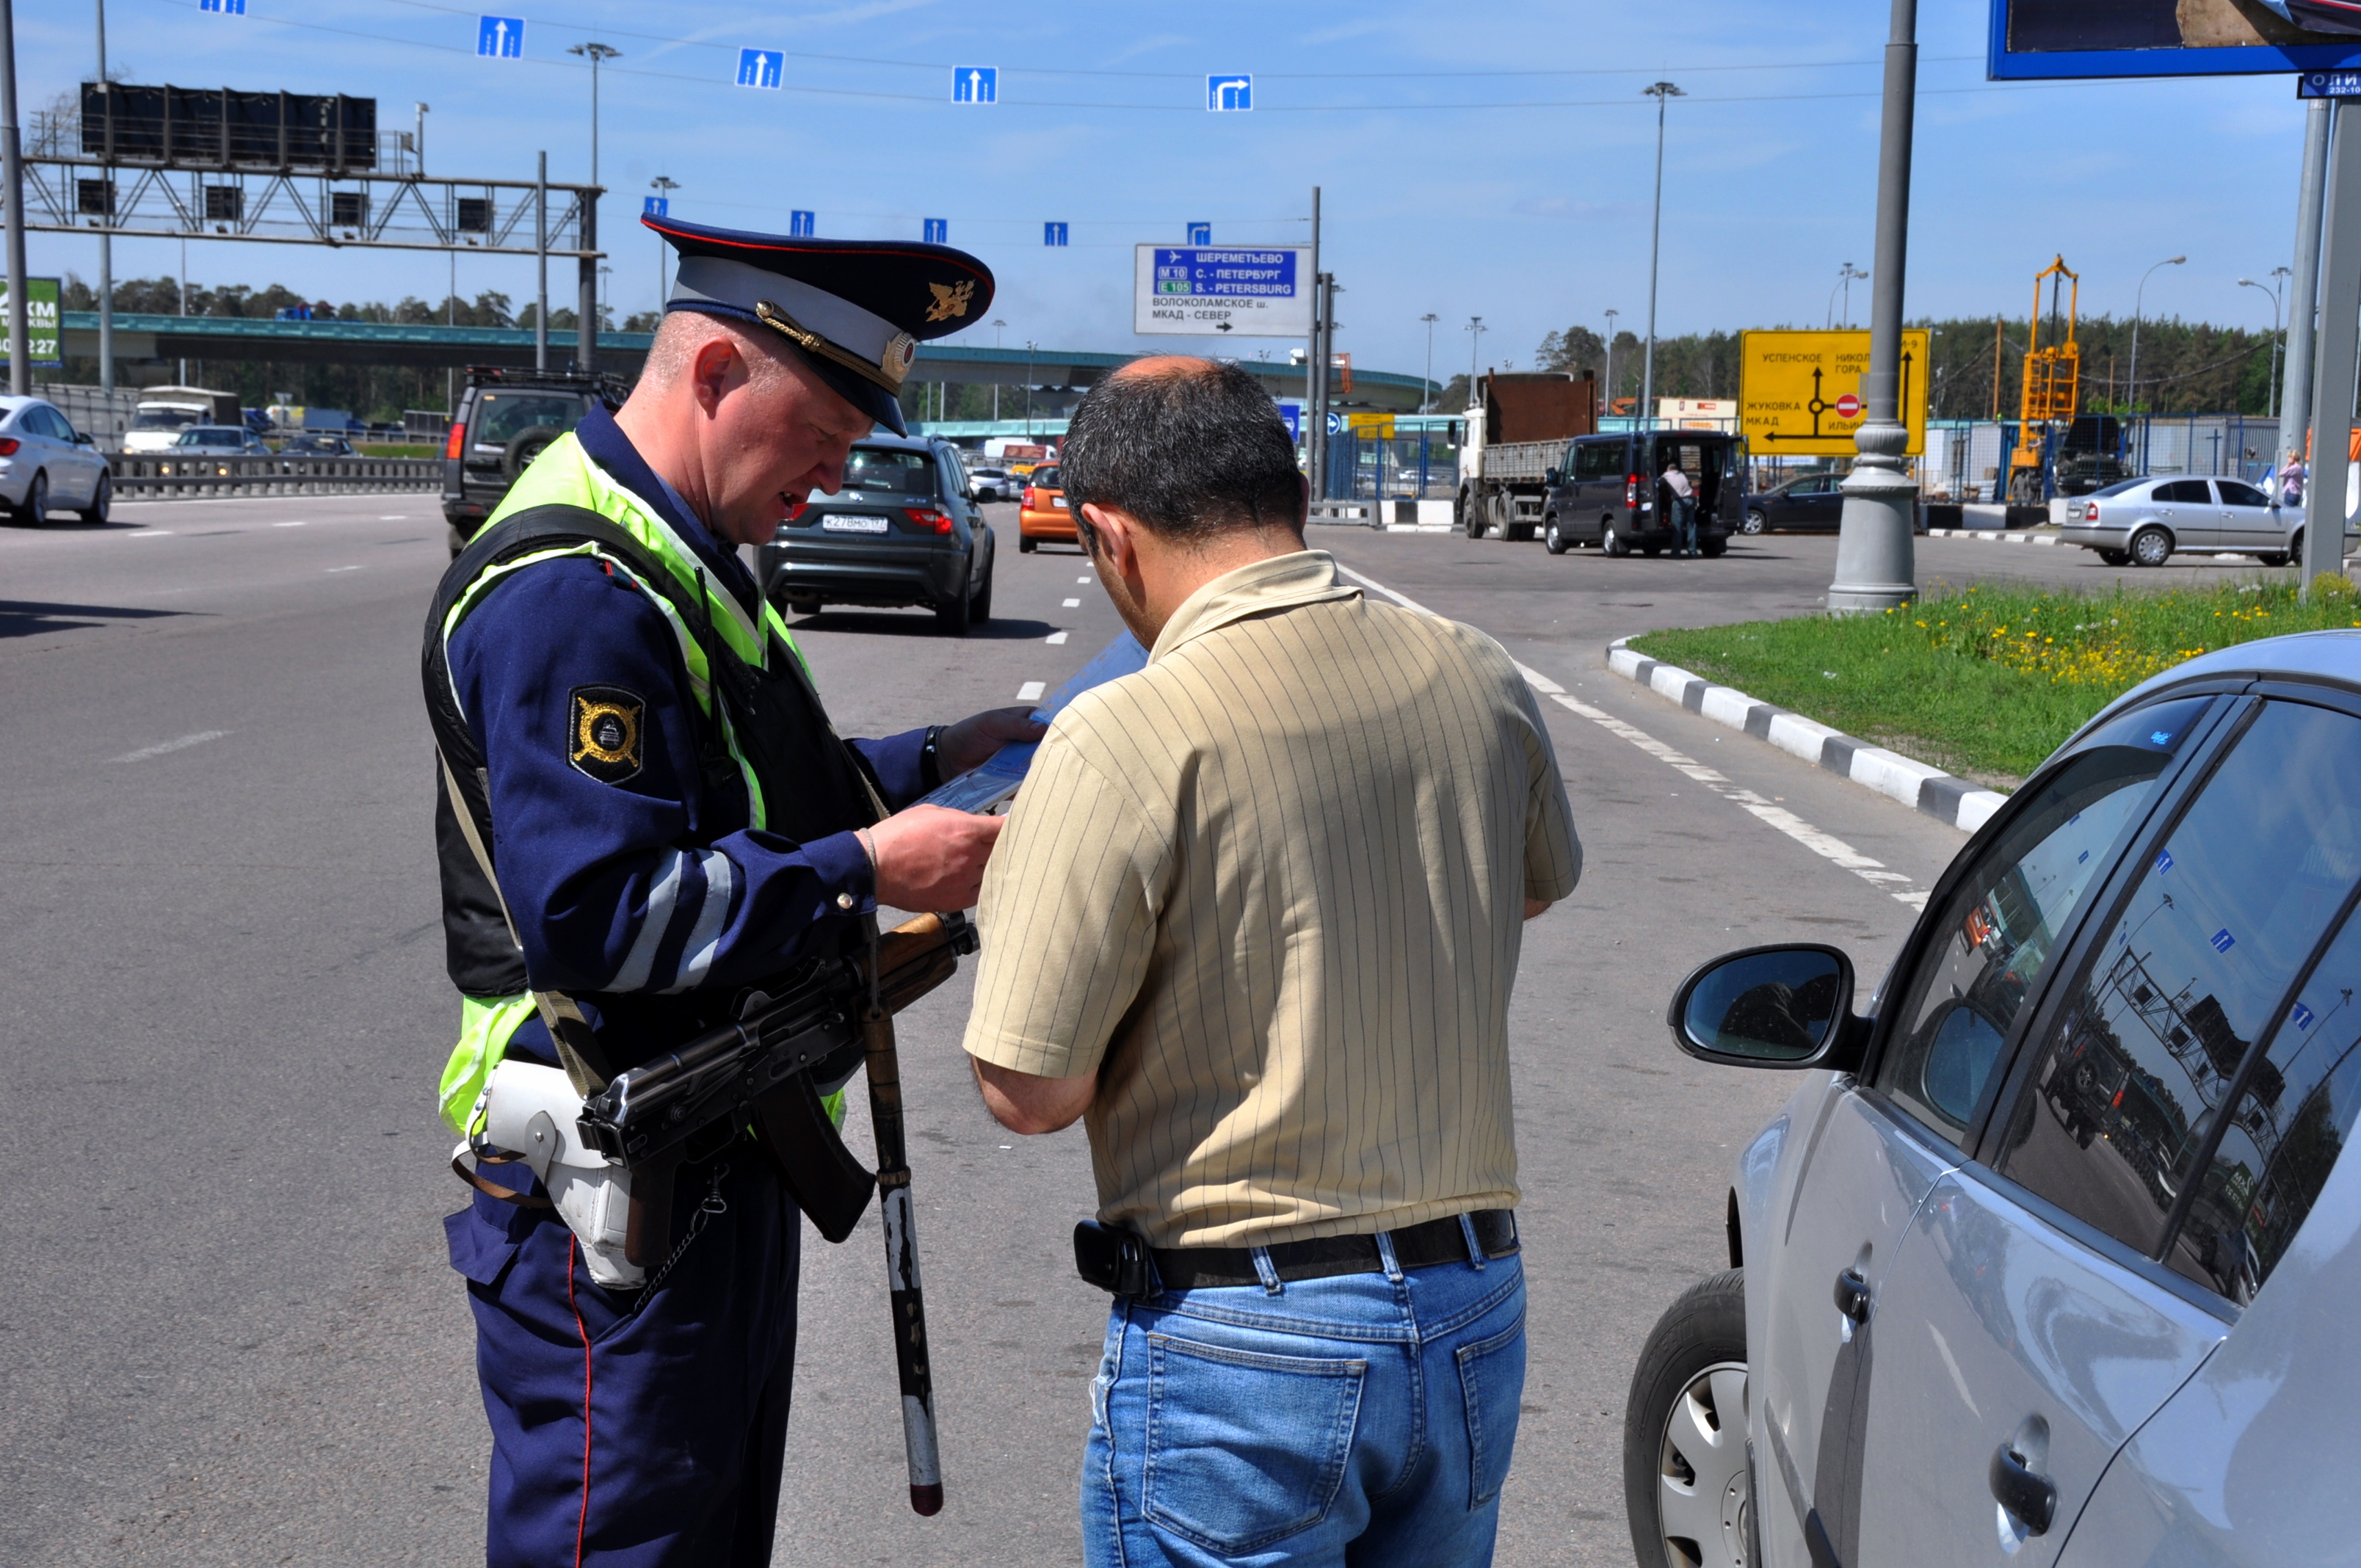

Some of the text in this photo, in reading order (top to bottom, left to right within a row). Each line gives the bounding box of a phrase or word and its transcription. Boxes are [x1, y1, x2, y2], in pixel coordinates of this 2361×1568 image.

[1196, 253, 1284, 264] ШЕРЕМЕТЬЕВО
[1173, 269, 1185, 277] 10
[1216, 269, 1281, 280] ПЕТЕРБУРГ
[1161, 283, 1189, 292] E 105
[1195, 283, 1206, 293] S.
[1216, 283, 1291, 294] PETERSBURG
[1153, 297, 1253, 308] ВОЛОКОЛАМСКОЕ
[1153, 311, 1184, 320] МКАД
[1194, 311, 1231, 320] СЕВЕР
[1762, 353, 1822, 363] УСПЕНСКОЕ
[1836, 353, 1870, 363] НИКОЛ
[1835, 365, 1862, 374] ГОРА
[1747, 402, 1801, 411] ЖУКОВКА
[1746, 417, 1780, 427] МКАД
[1829, 421, 1863, 430] ИЛЬИН
